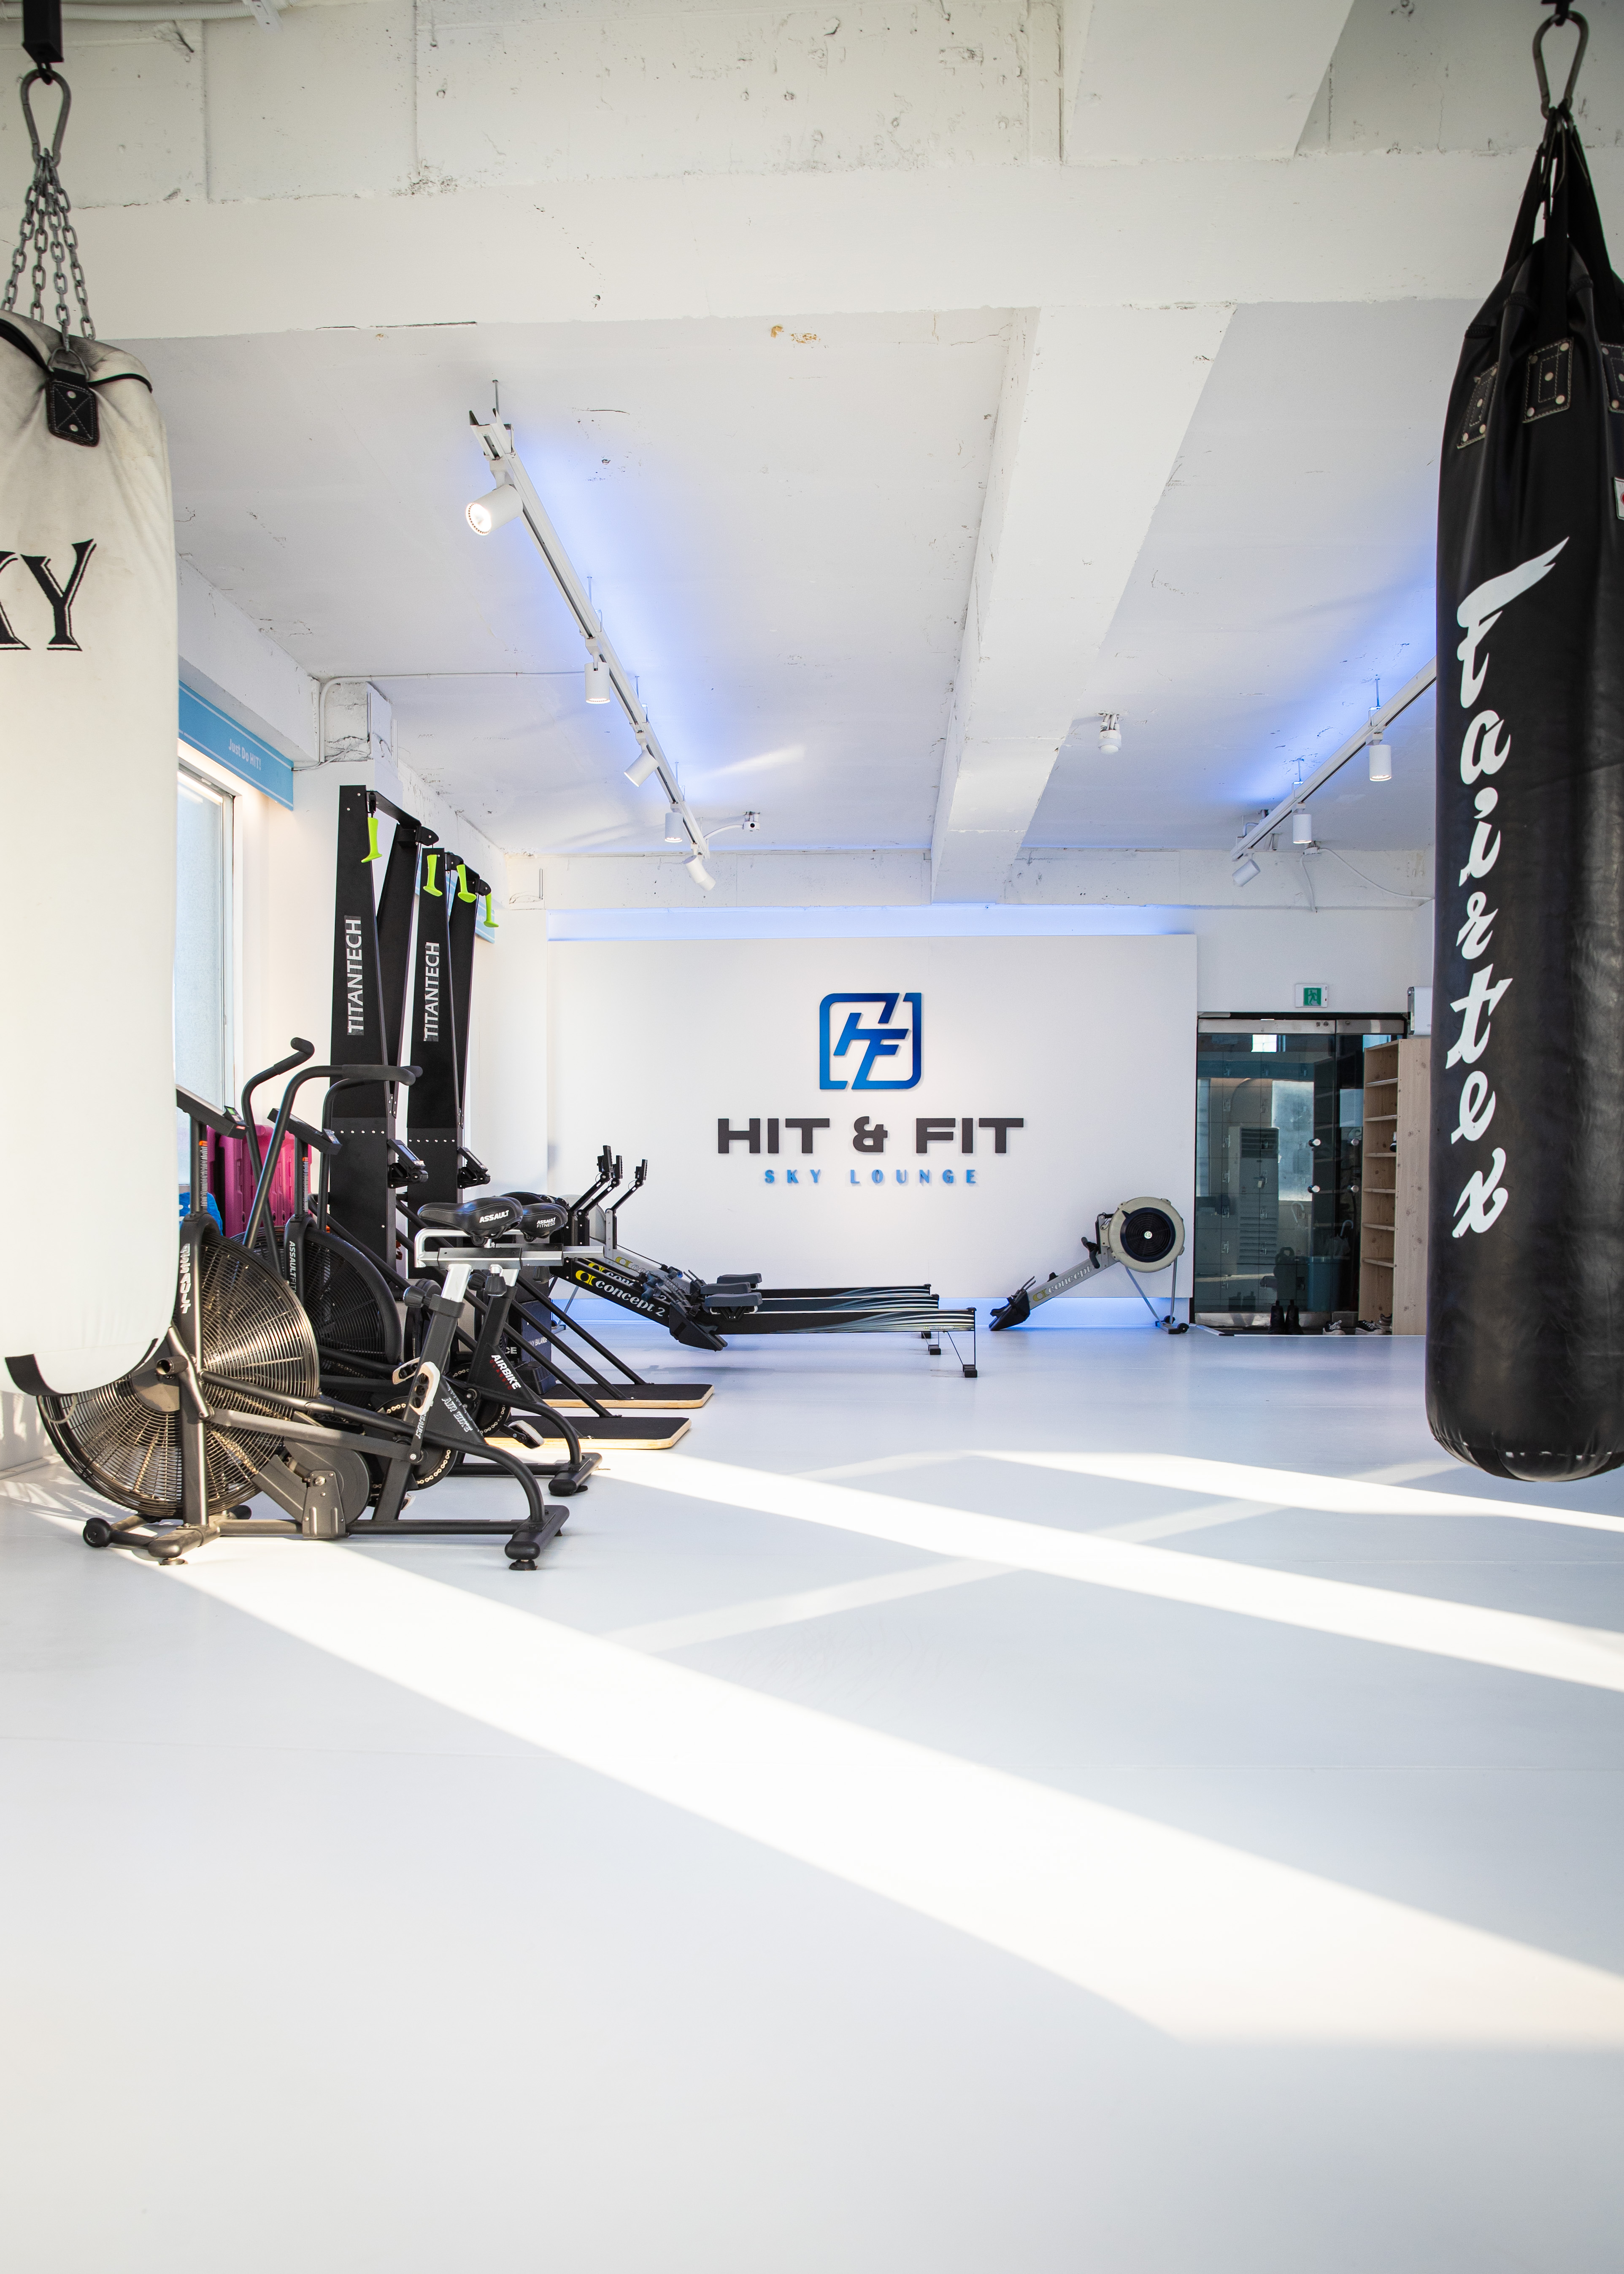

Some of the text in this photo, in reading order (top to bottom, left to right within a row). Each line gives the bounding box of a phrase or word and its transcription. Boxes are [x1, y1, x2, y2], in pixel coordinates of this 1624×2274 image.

[228, 738, 261, 771] Just Do HIT!
[1446, 537, 1569, 1238] Fairtex
[346, 919, 364, 1033] TITANTECH
[425, 942, 440, 1039] TITANTECH
[718, 1115, 1024, 1154] HIT & FIT
[764, 1169, 977, 1184] SKY LOUNGE
[479, 1210, 509, 1223] ASSAULT
[536, 1217, 556, 1225] ASSAULT
[180, 1243, 192, 1314] ASSAULT
[1048, 1266, 1092, 1293] concept
[595, 1280, 666, 1317] concept 2
[491, 1354, 522, 1390] AIRBIKE
